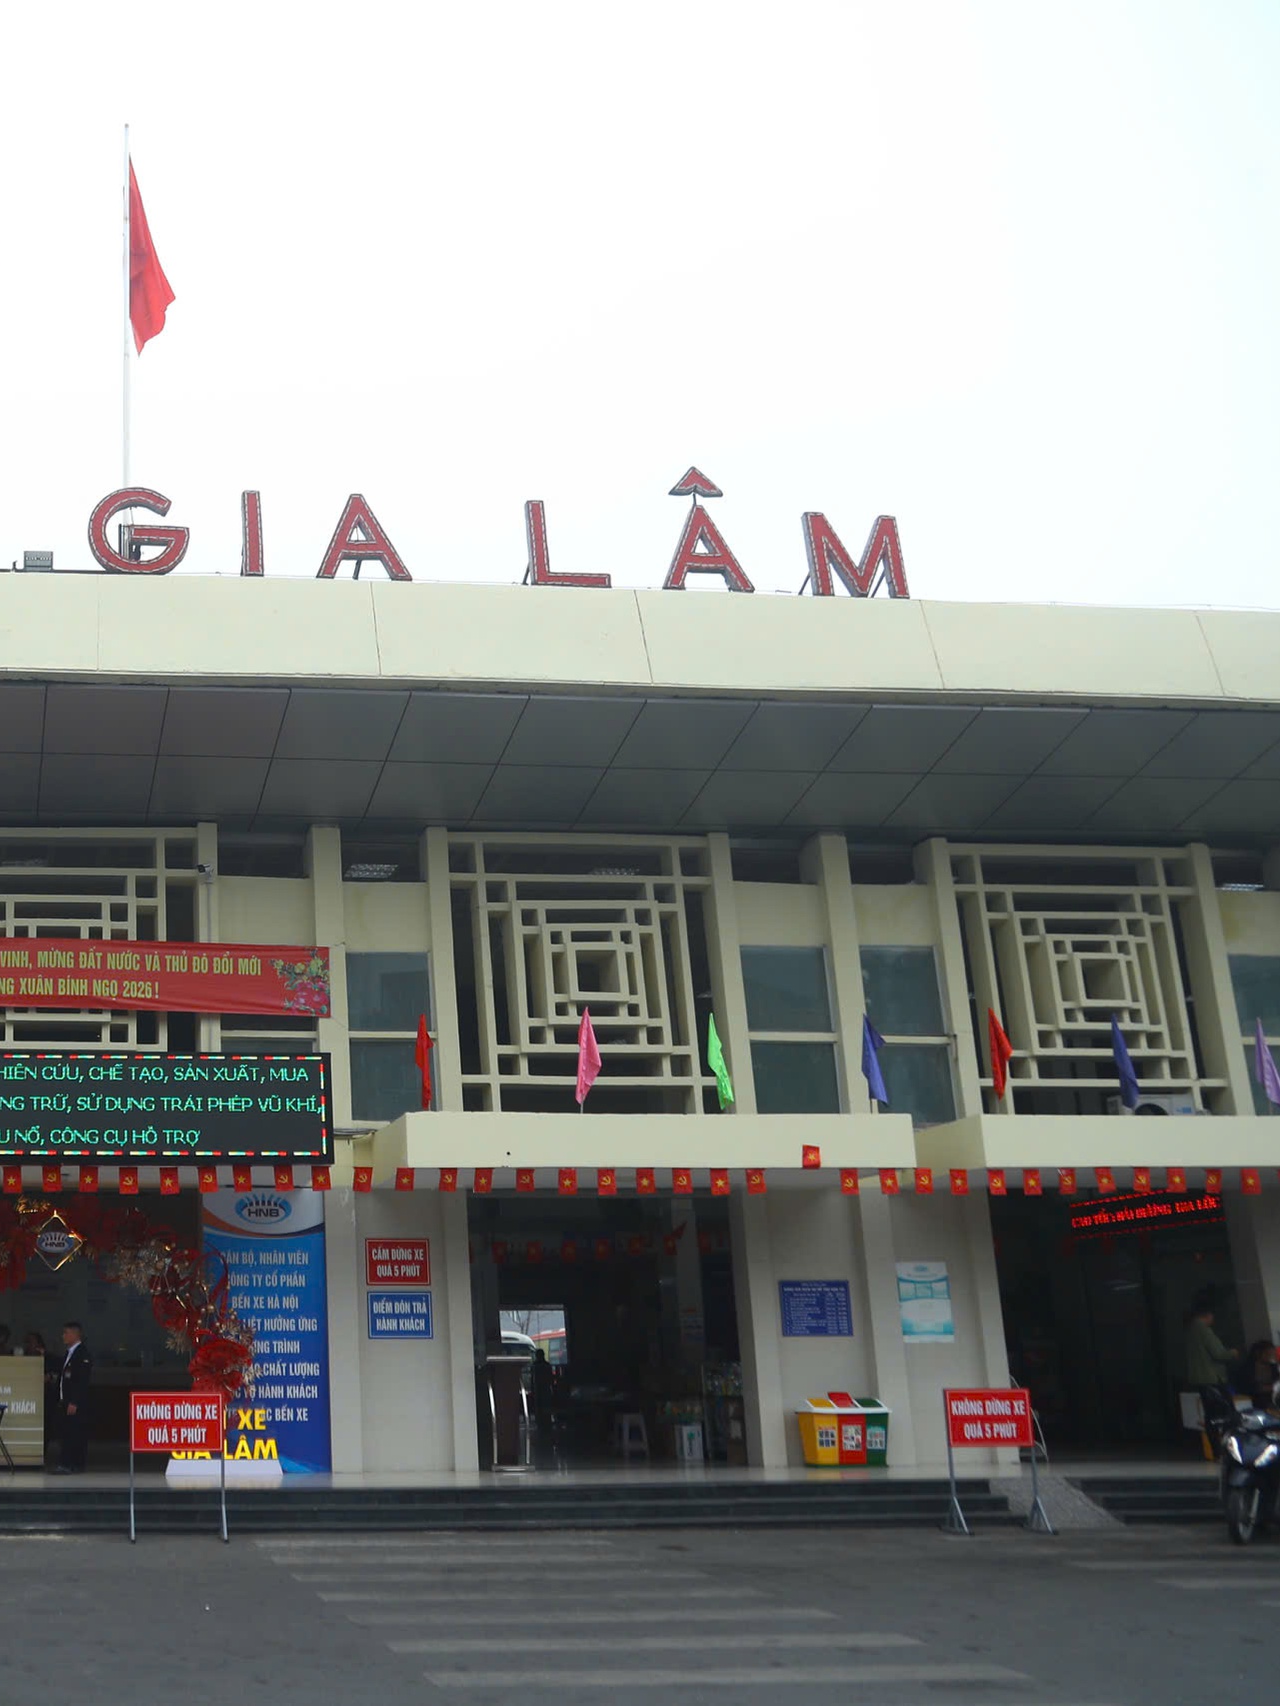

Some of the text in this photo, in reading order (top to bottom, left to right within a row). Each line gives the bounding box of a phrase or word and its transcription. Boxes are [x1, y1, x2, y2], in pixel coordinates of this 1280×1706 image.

[88, 486, 412, 581] GIA
[524, 466, 910, 598] LÂM
[0, 950, 32, 970] VINH,
[37, 947, 74, 968] MỪNG
[79, 946, 103, 969] ĐẤT
[107, 949, 141, 971] NƯỚC
[145, 951, 161, 972] VÀ
[165, 950, 187, 973] THỦ
[213, 951, 233, 975] ĐỔI
[238, 955, 261, 976] MỚI
[19, 974, 53, 995] XUÂN
[58, 975, 88, 996] BÍNH
[93, 979, 118, 1000] NGỌ
[41, 1062, 84, 1083] CỨU,
[129, 1066, 169, 1084] TẠO,
[173, 1063, 209, 1081] SẢN
[269, 1067, 309, 1082] MUA
[76, 1092, 102, 1111] SỬ
[105, 1096, 155, 1114] DỤNG
[160, 1094, 203, 1112] TRÁI
[207, 1094, 253, 1112] PHÉP
[257, 1094, 282, 1112] VŨ
[285, 1094, 322, 1115] KHÍ,
[50, 1126, 99, 1145] CÔNG
[103, 1129, 128, 1147] CỤ
[162, 1129, 201, 1147] TRỢ
[247, 1208, 280, 1217] HNB
[260, 1250, 285, 1265] NHÂN
[288, 1250, 309, 1265] VIÊN
[372, 1245, 424, 1260] CẤM DỪNG XE
[376, 1263, 420, 1278] QUÁ 5 PHÚT
[252, 1274, 262, 1287] TY
[231, 1292, 299, 1311] BẾN XE HÀ NỘI
[373, 1297, 427, 1314] ĐIỂM ĐÓN TRẢ
[264, 1315, 296, 1332] HƯỞNG
[376, 1316, 425, 1331] HÀNH KHÁCH
[272, 1338, 300, 1354] TRÌNH
[263, 1360, 287, 1376] CHẤT
[289, 1363, 320, 1379] LƯỢNG
[258, 1384, 284, 1399] HÀNH
[286, 1384, 318, 1399] KHÁCH
[136, 1401, 171, 1420] KHÔNG
[174, 1401, 202, 1420] DỪNG
[205, 1405, 218, 1420] XE
[275, 1405, 293, 1422] BẾN
[296, 1408, 308, 1422] XE
[951, 1397, 1026, 1416] KHÔNG DỪNG XE
[237, 1408, 267, 1430] XE
[148, 1424, 207, 1444] QUÁ 5 PHÚT
[963, 1420, 1017, 1440] QUÁ 5 PHÚT
[223, 1434, 278, 1460] LÂM
